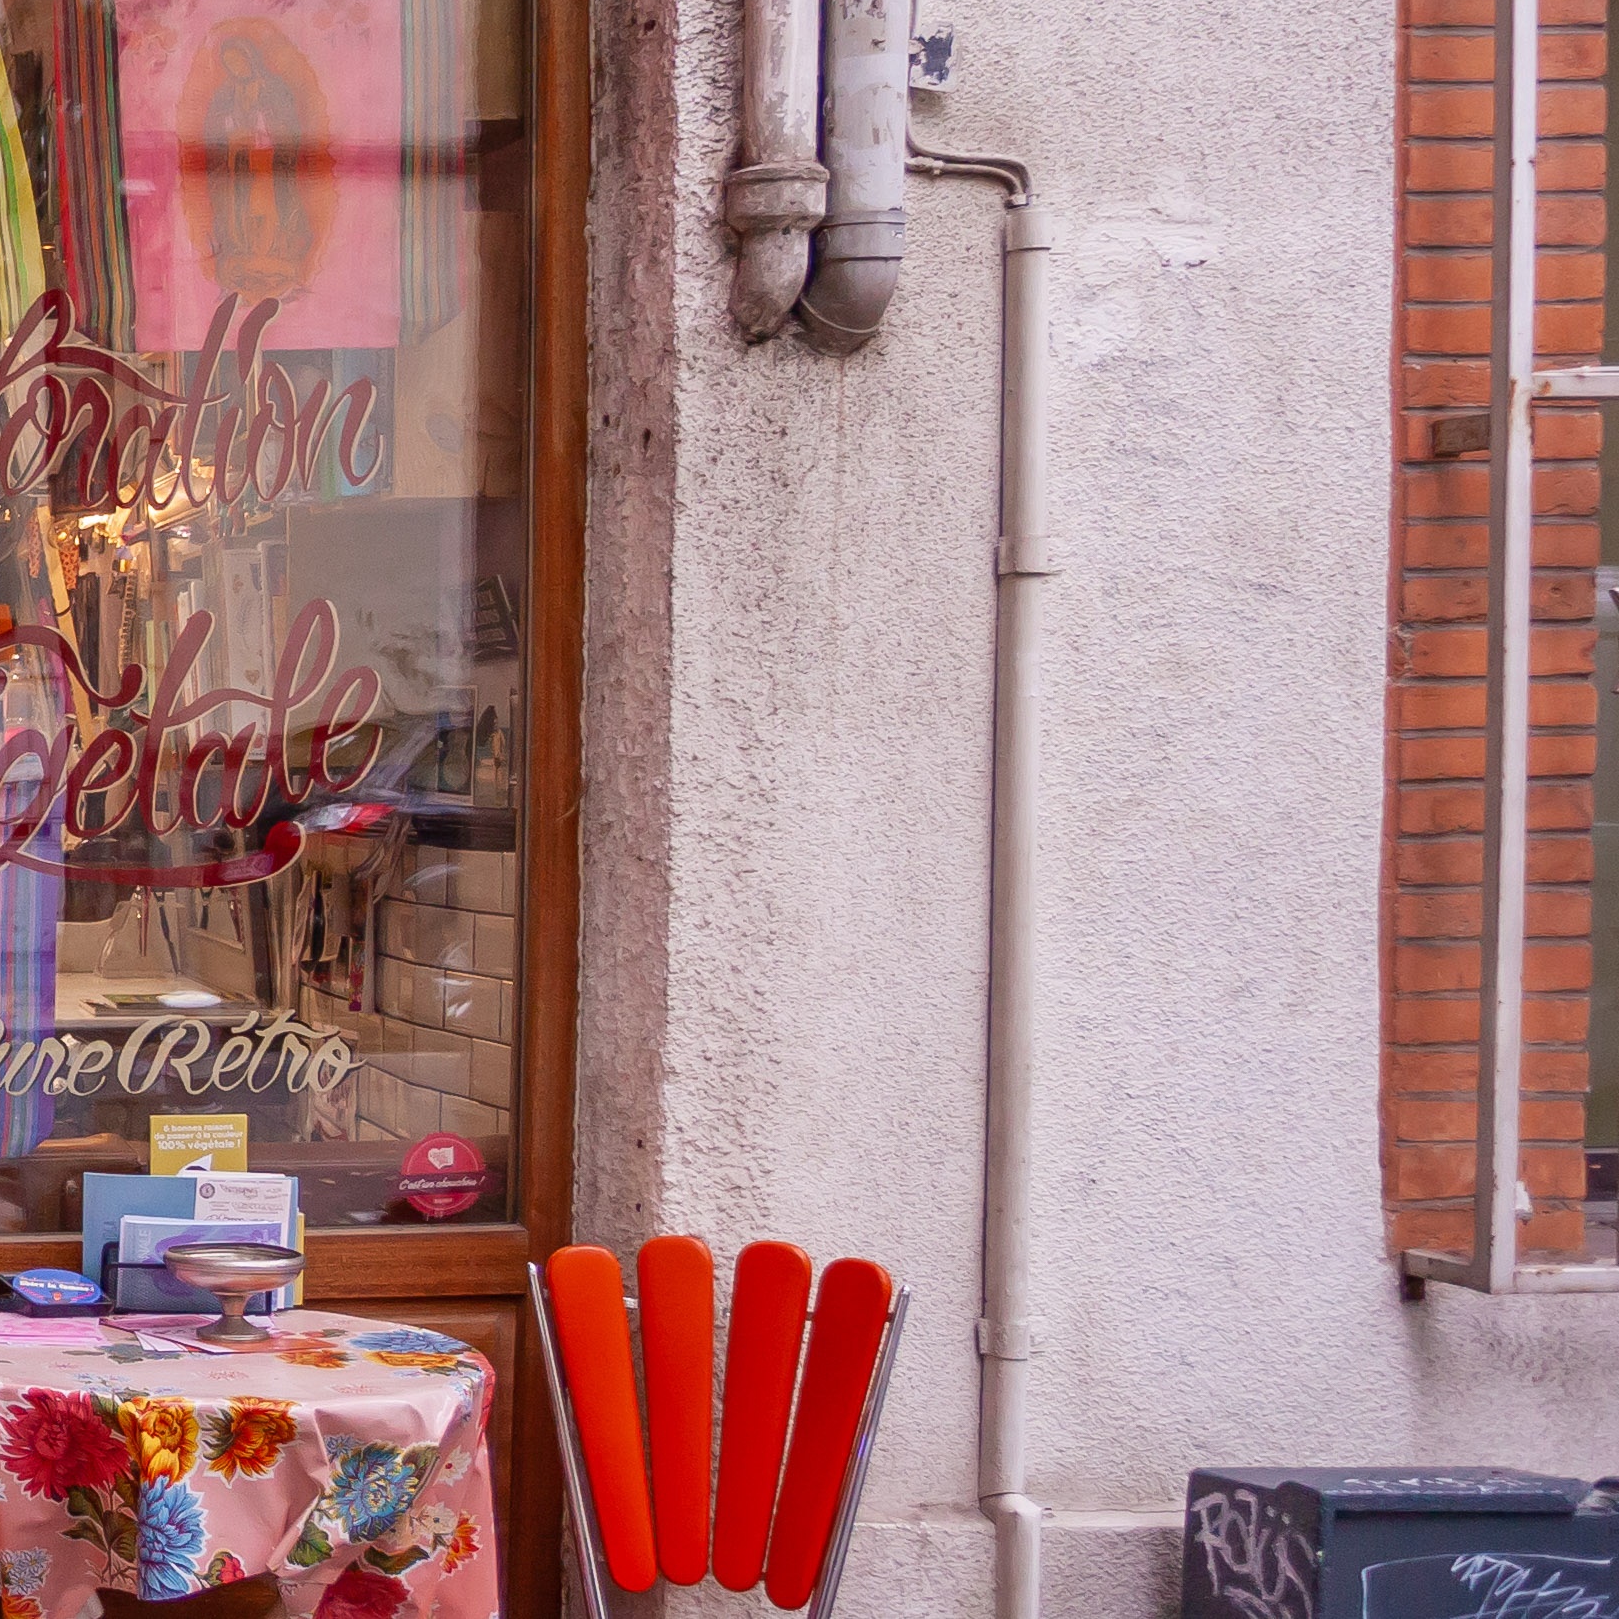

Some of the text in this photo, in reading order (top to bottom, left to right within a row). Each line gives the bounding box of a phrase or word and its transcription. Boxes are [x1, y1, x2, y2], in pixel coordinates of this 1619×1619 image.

[116, 1008, 367, 1097] Rétro
[171, 1124, 202, 1132] bonnes
[212, 1131, 244, 1139] couleur
[157, 1141, 187, 1150] 100%
[187, 1140, 235, 1151] végétale
